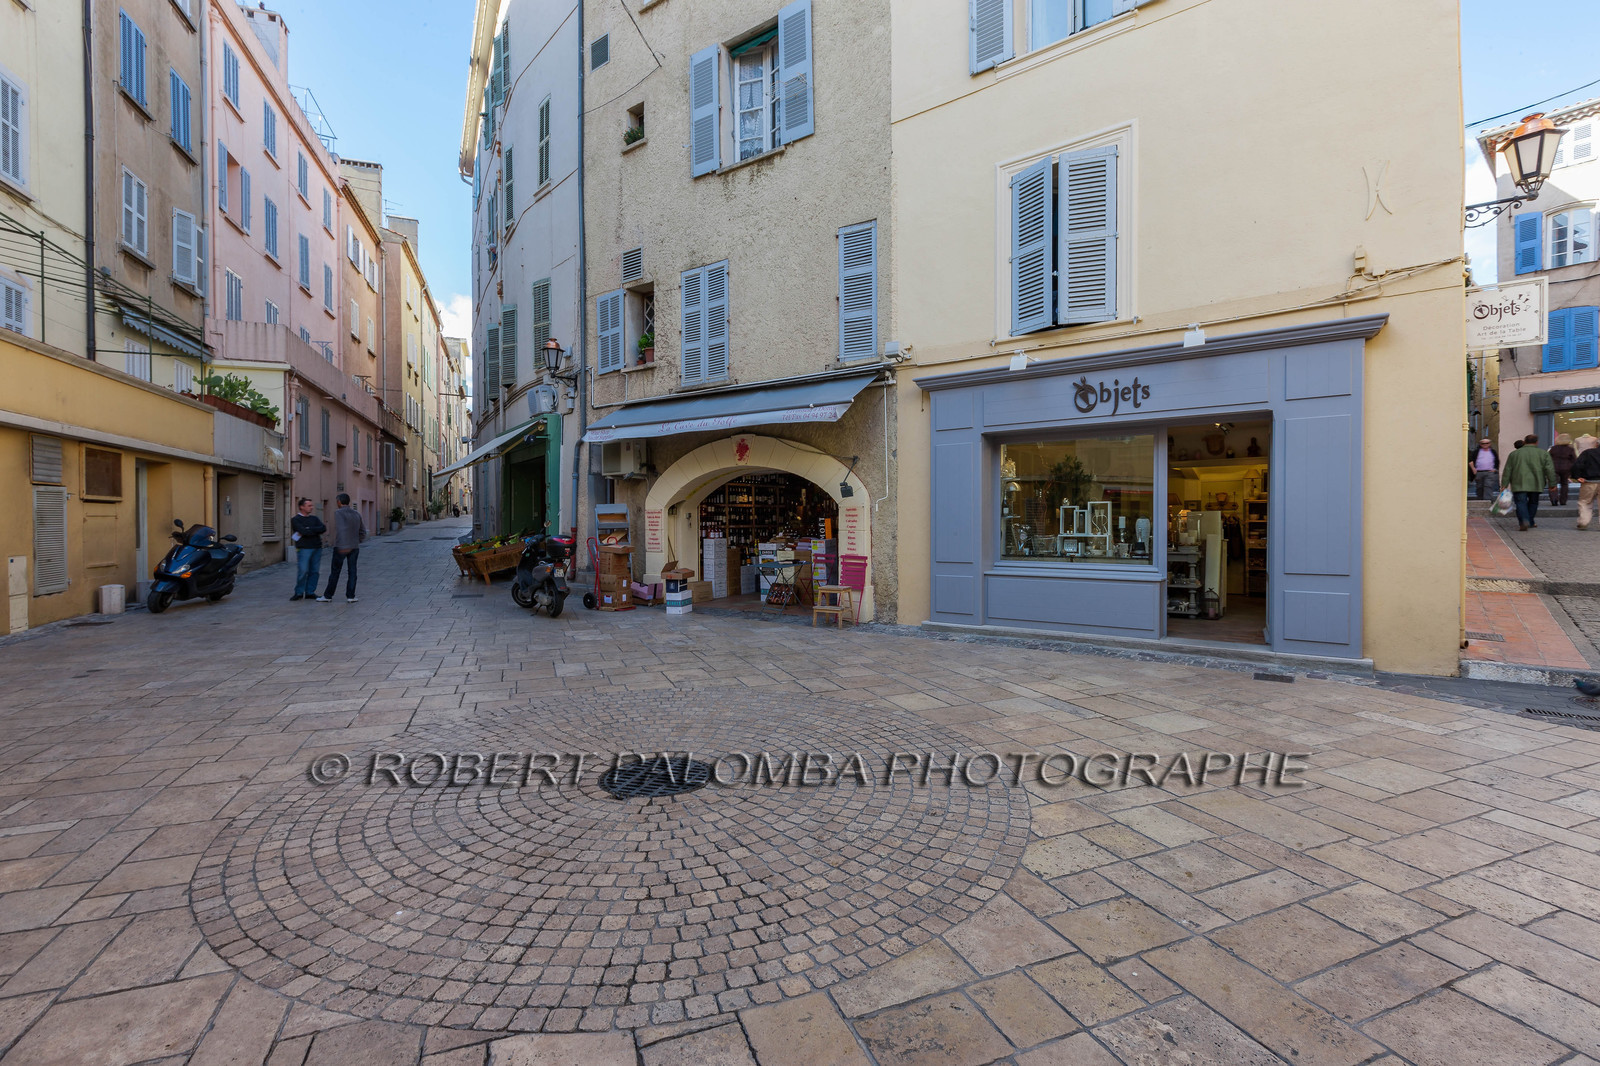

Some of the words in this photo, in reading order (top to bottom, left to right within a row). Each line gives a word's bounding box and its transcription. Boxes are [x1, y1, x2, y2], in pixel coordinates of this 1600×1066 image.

[1473, 300, 1521, 322] Objets
[1072, 376, 1151, 416] Objets
[697, 420, 708, 428] du
